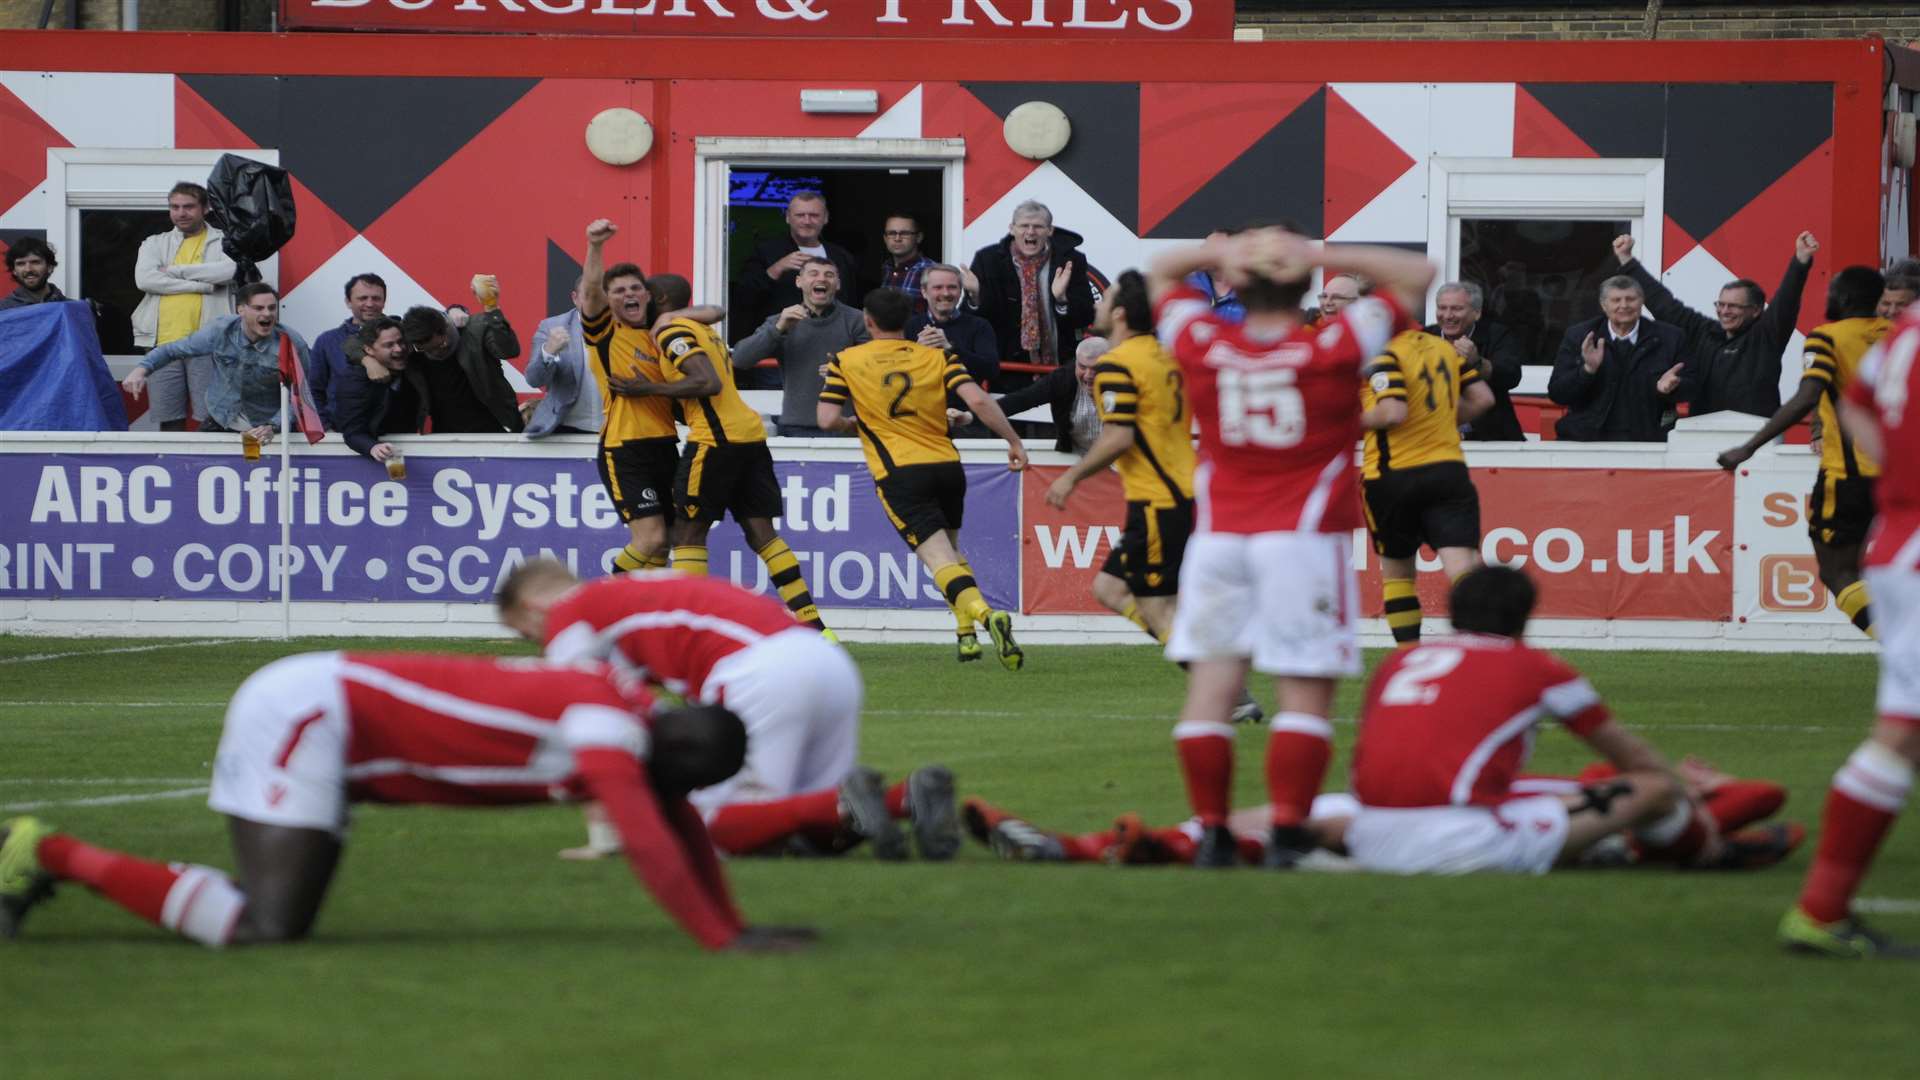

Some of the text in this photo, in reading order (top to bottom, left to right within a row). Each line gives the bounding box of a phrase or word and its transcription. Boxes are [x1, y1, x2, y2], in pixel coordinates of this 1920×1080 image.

[883, 371, 919, 419] 2
[1216, 367, 1307, 448] 15
[1419, 357, 1455, 412] 11
[30, 465, 172, 524] ARC
[198, 466, 408, 527] Office
[771, 474, 850, 532] td
[0, 543, 114, 590] INT
[173, 543, 347, 593] COPY
[1380, 645, 1467, 706] 2
